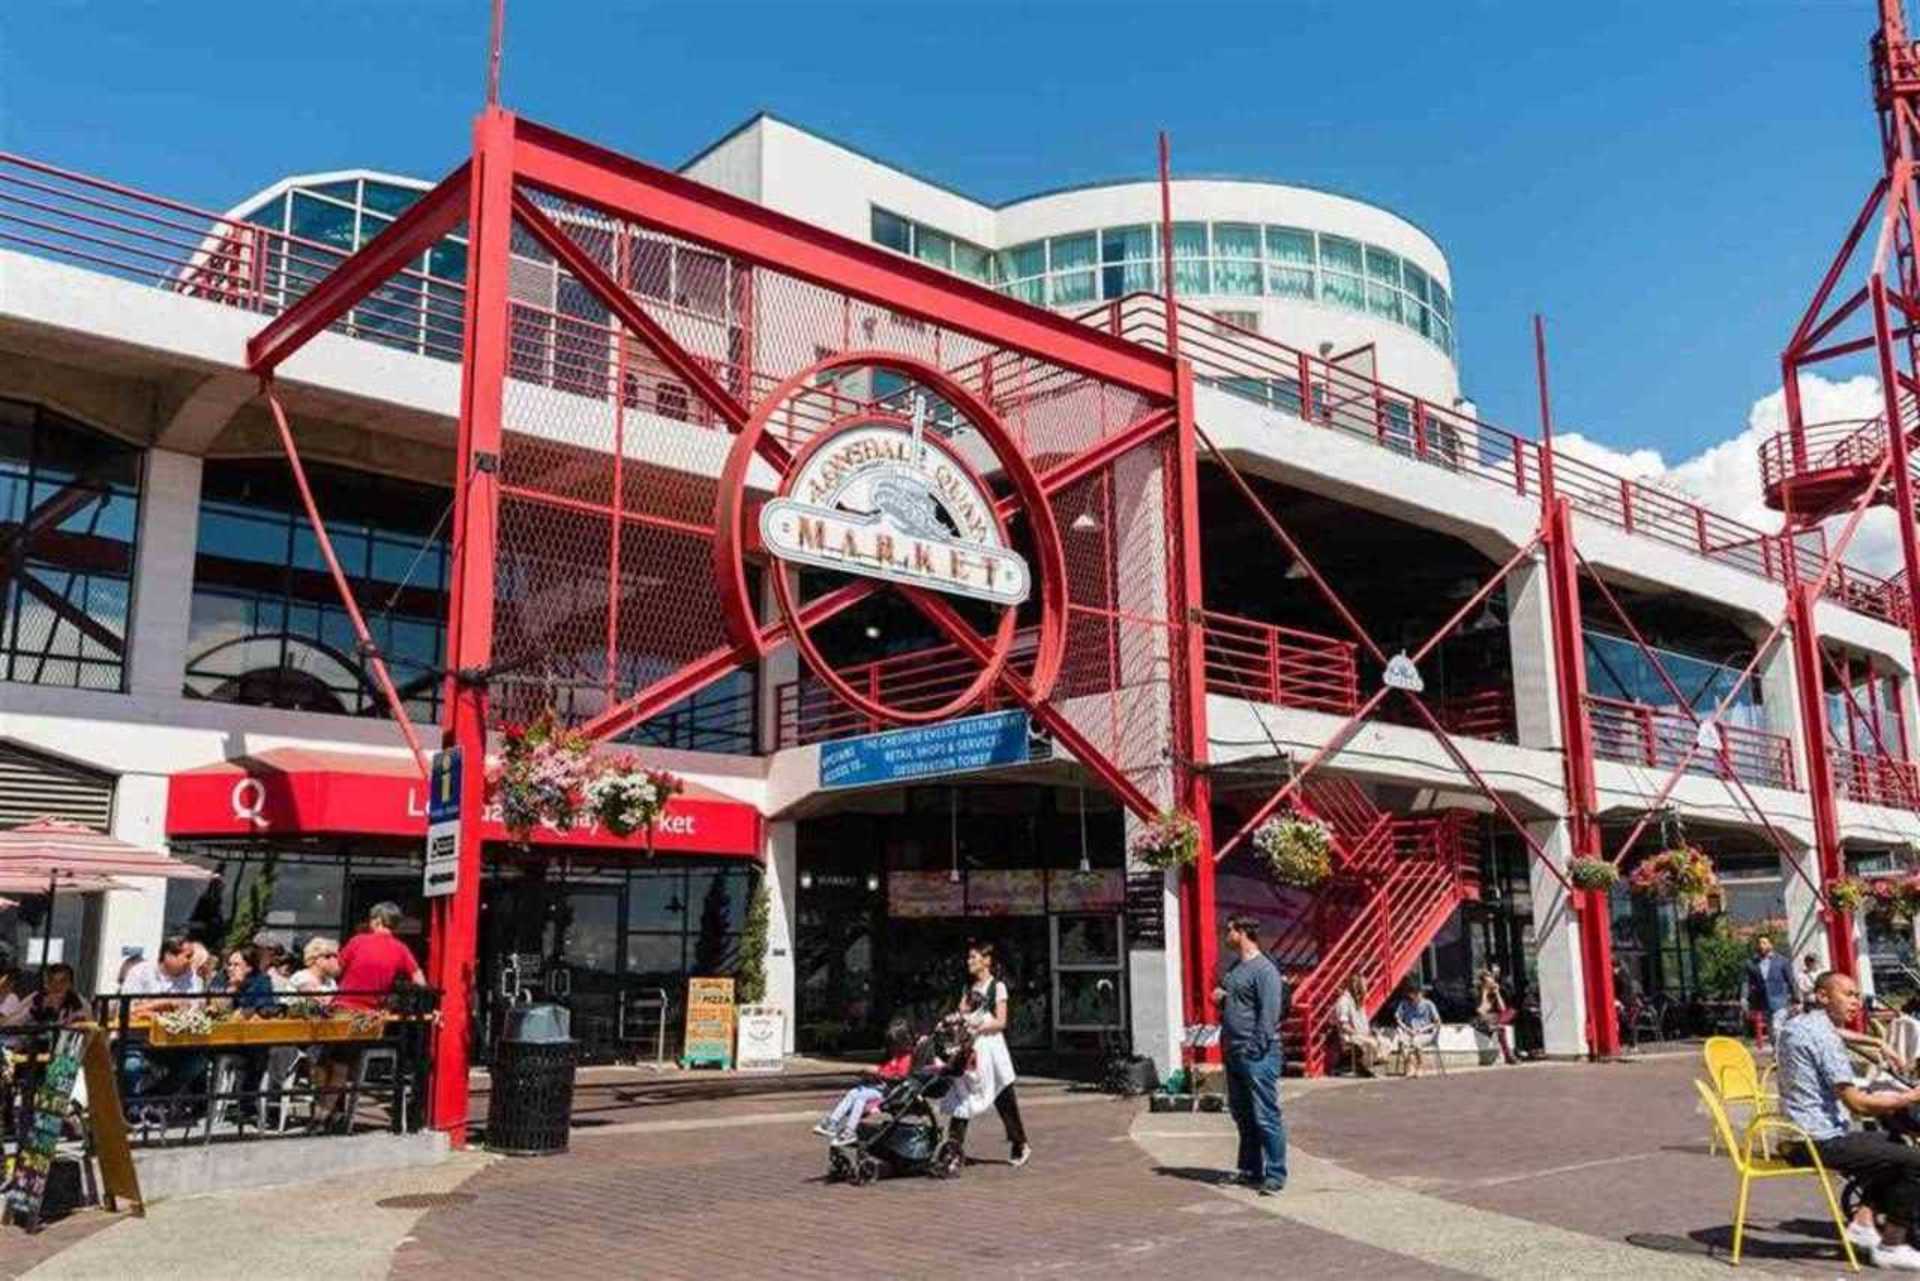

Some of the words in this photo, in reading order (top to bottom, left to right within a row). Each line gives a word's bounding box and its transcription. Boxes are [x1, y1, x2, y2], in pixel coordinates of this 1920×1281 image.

[936, 465, 987, 544] QUAY
[798, 517, 1001, 590] MARKET
[959, 751, 992, 768] TOWER
[231, 777, 271, 828] Q
[703, 995, 730, 1005] PIZZA
